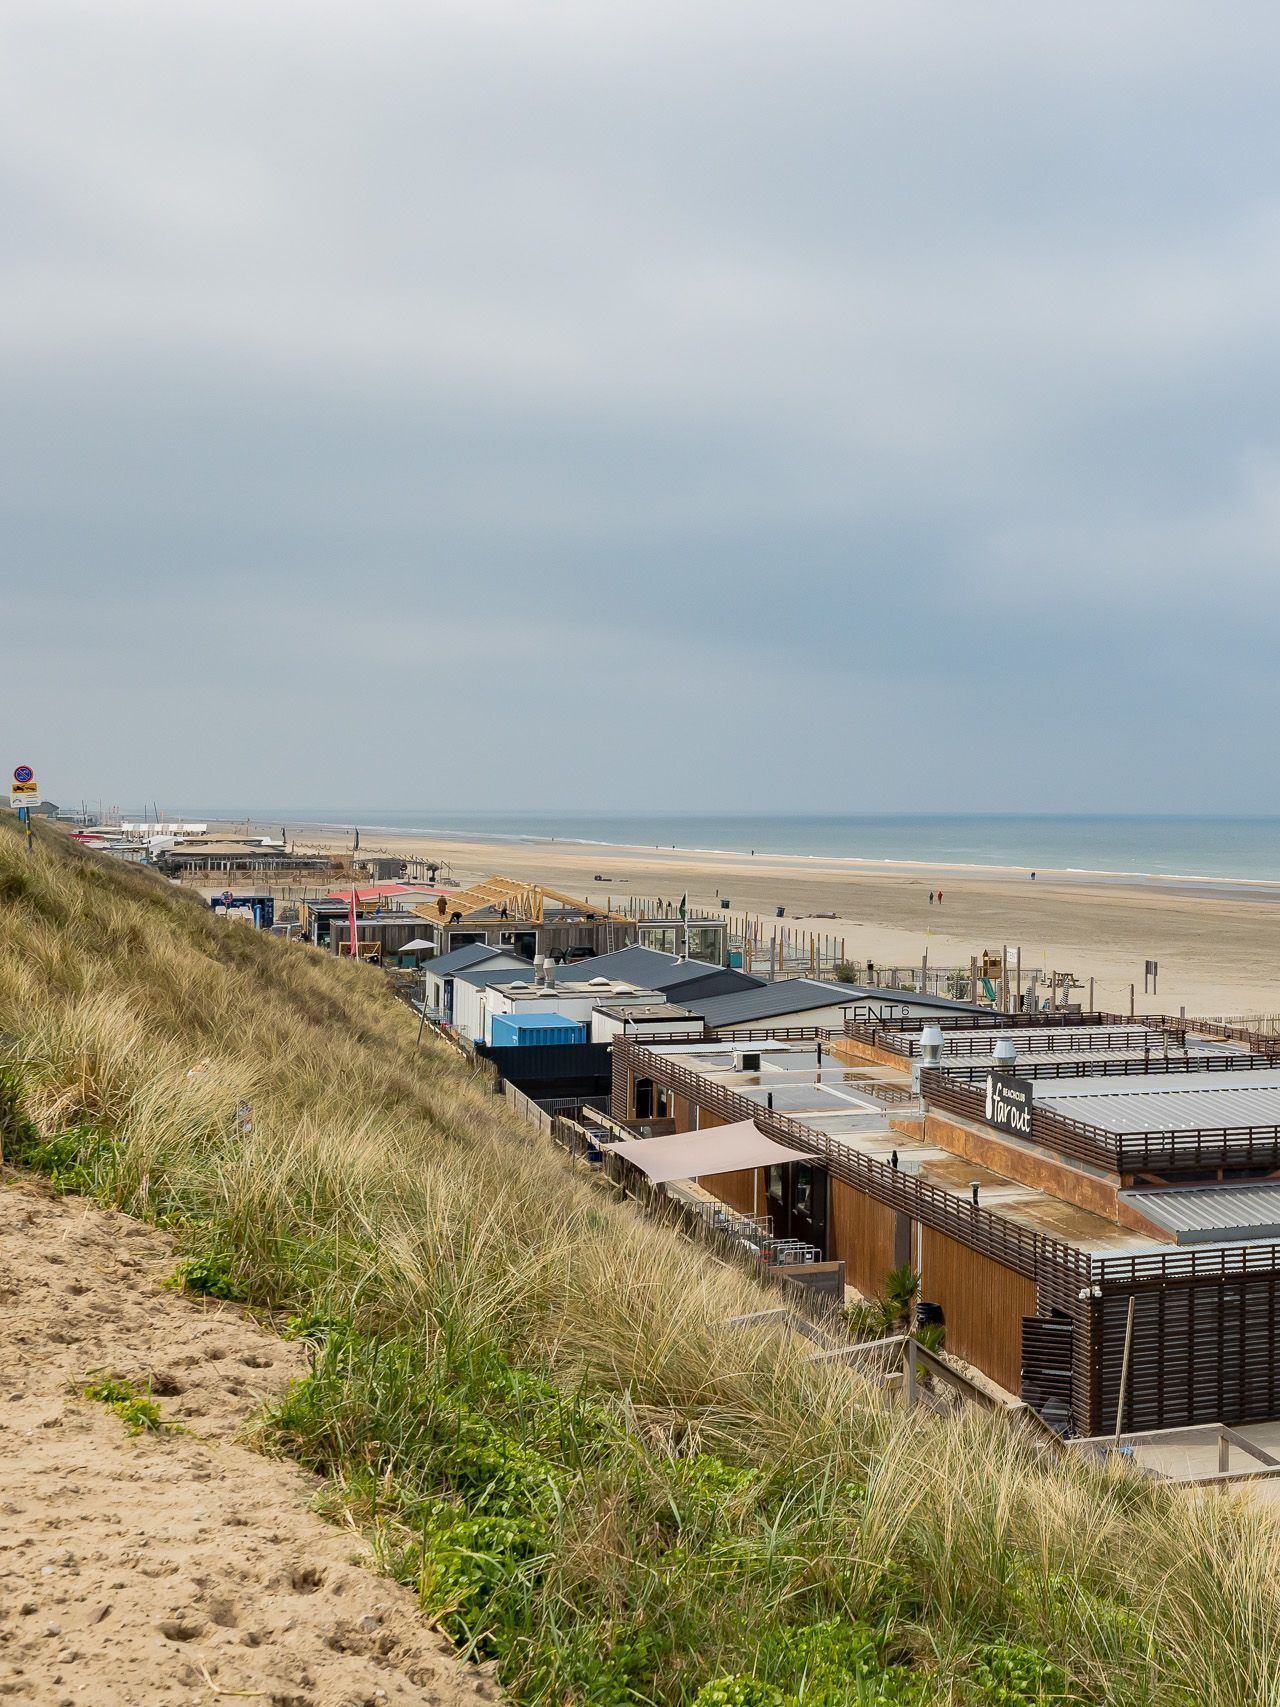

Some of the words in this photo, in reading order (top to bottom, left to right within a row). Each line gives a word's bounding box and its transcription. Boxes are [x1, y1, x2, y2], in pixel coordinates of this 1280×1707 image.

[838, 1005, 898, 1022] TENT
[901, 1005, 910, 1018] 6
[1002, 1087, 1026, 1103] BEACHCLUB
[993, 1082, 1011, 1123] far
[1010, 1106, 1031, 1133] out
